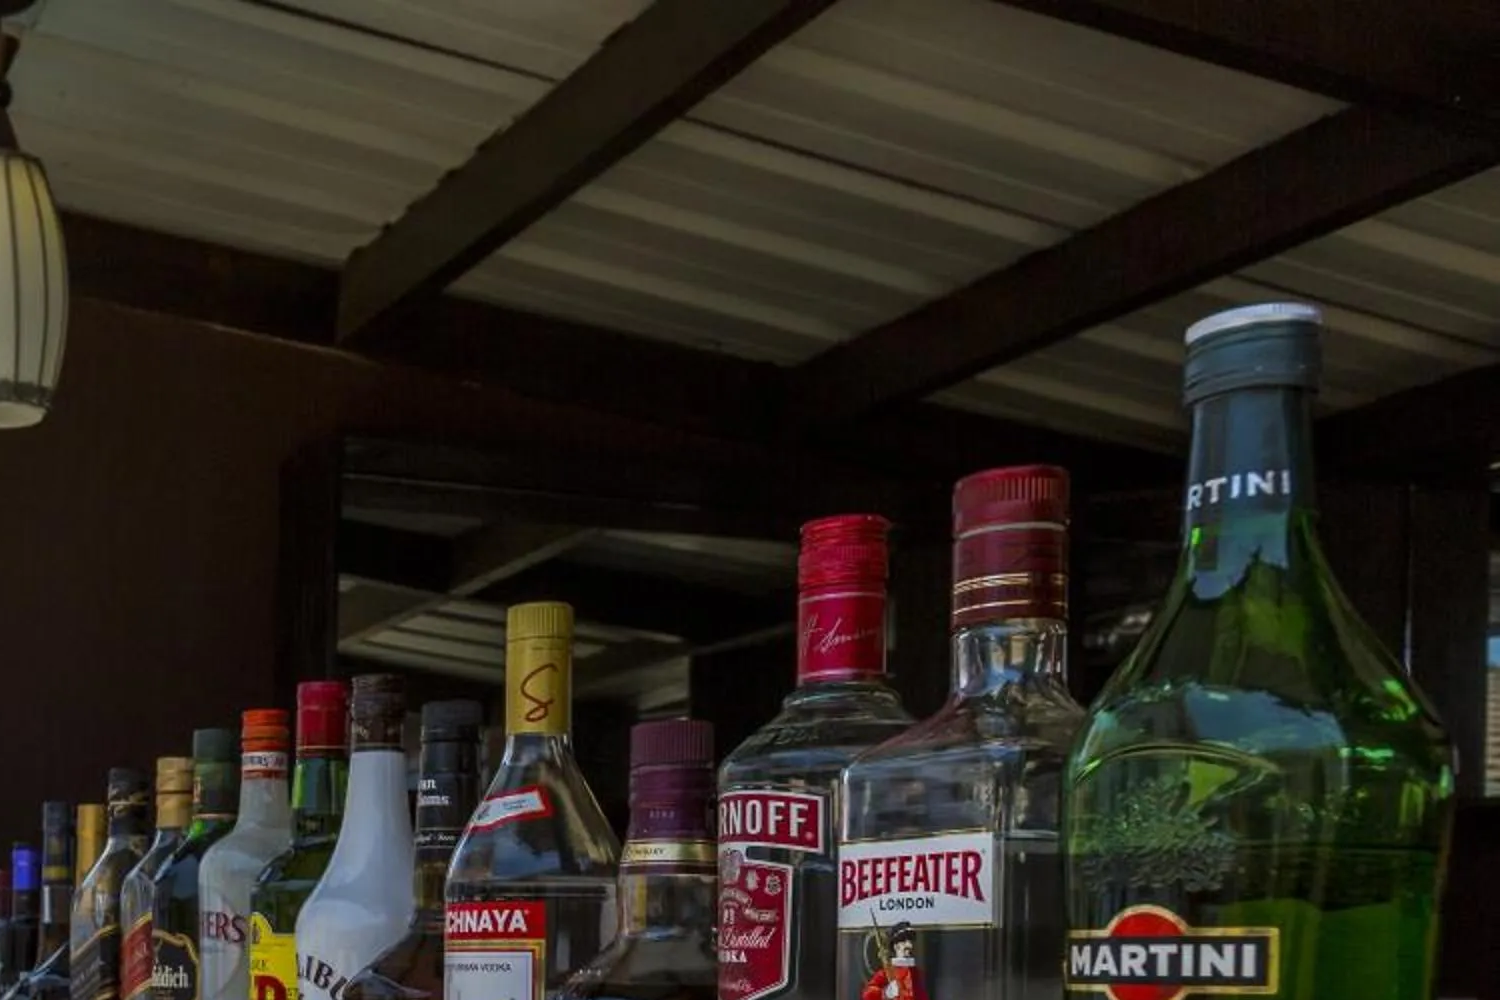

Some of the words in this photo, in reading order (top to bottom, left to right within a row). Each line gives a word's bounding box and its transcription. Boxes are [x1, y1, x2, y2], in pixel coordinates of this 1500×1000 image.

[841, 850, 986, 908] BEEFEATER
[879, 897, 935, 911] LONDON
[1070, 943, 1257, 977] MARTINI
